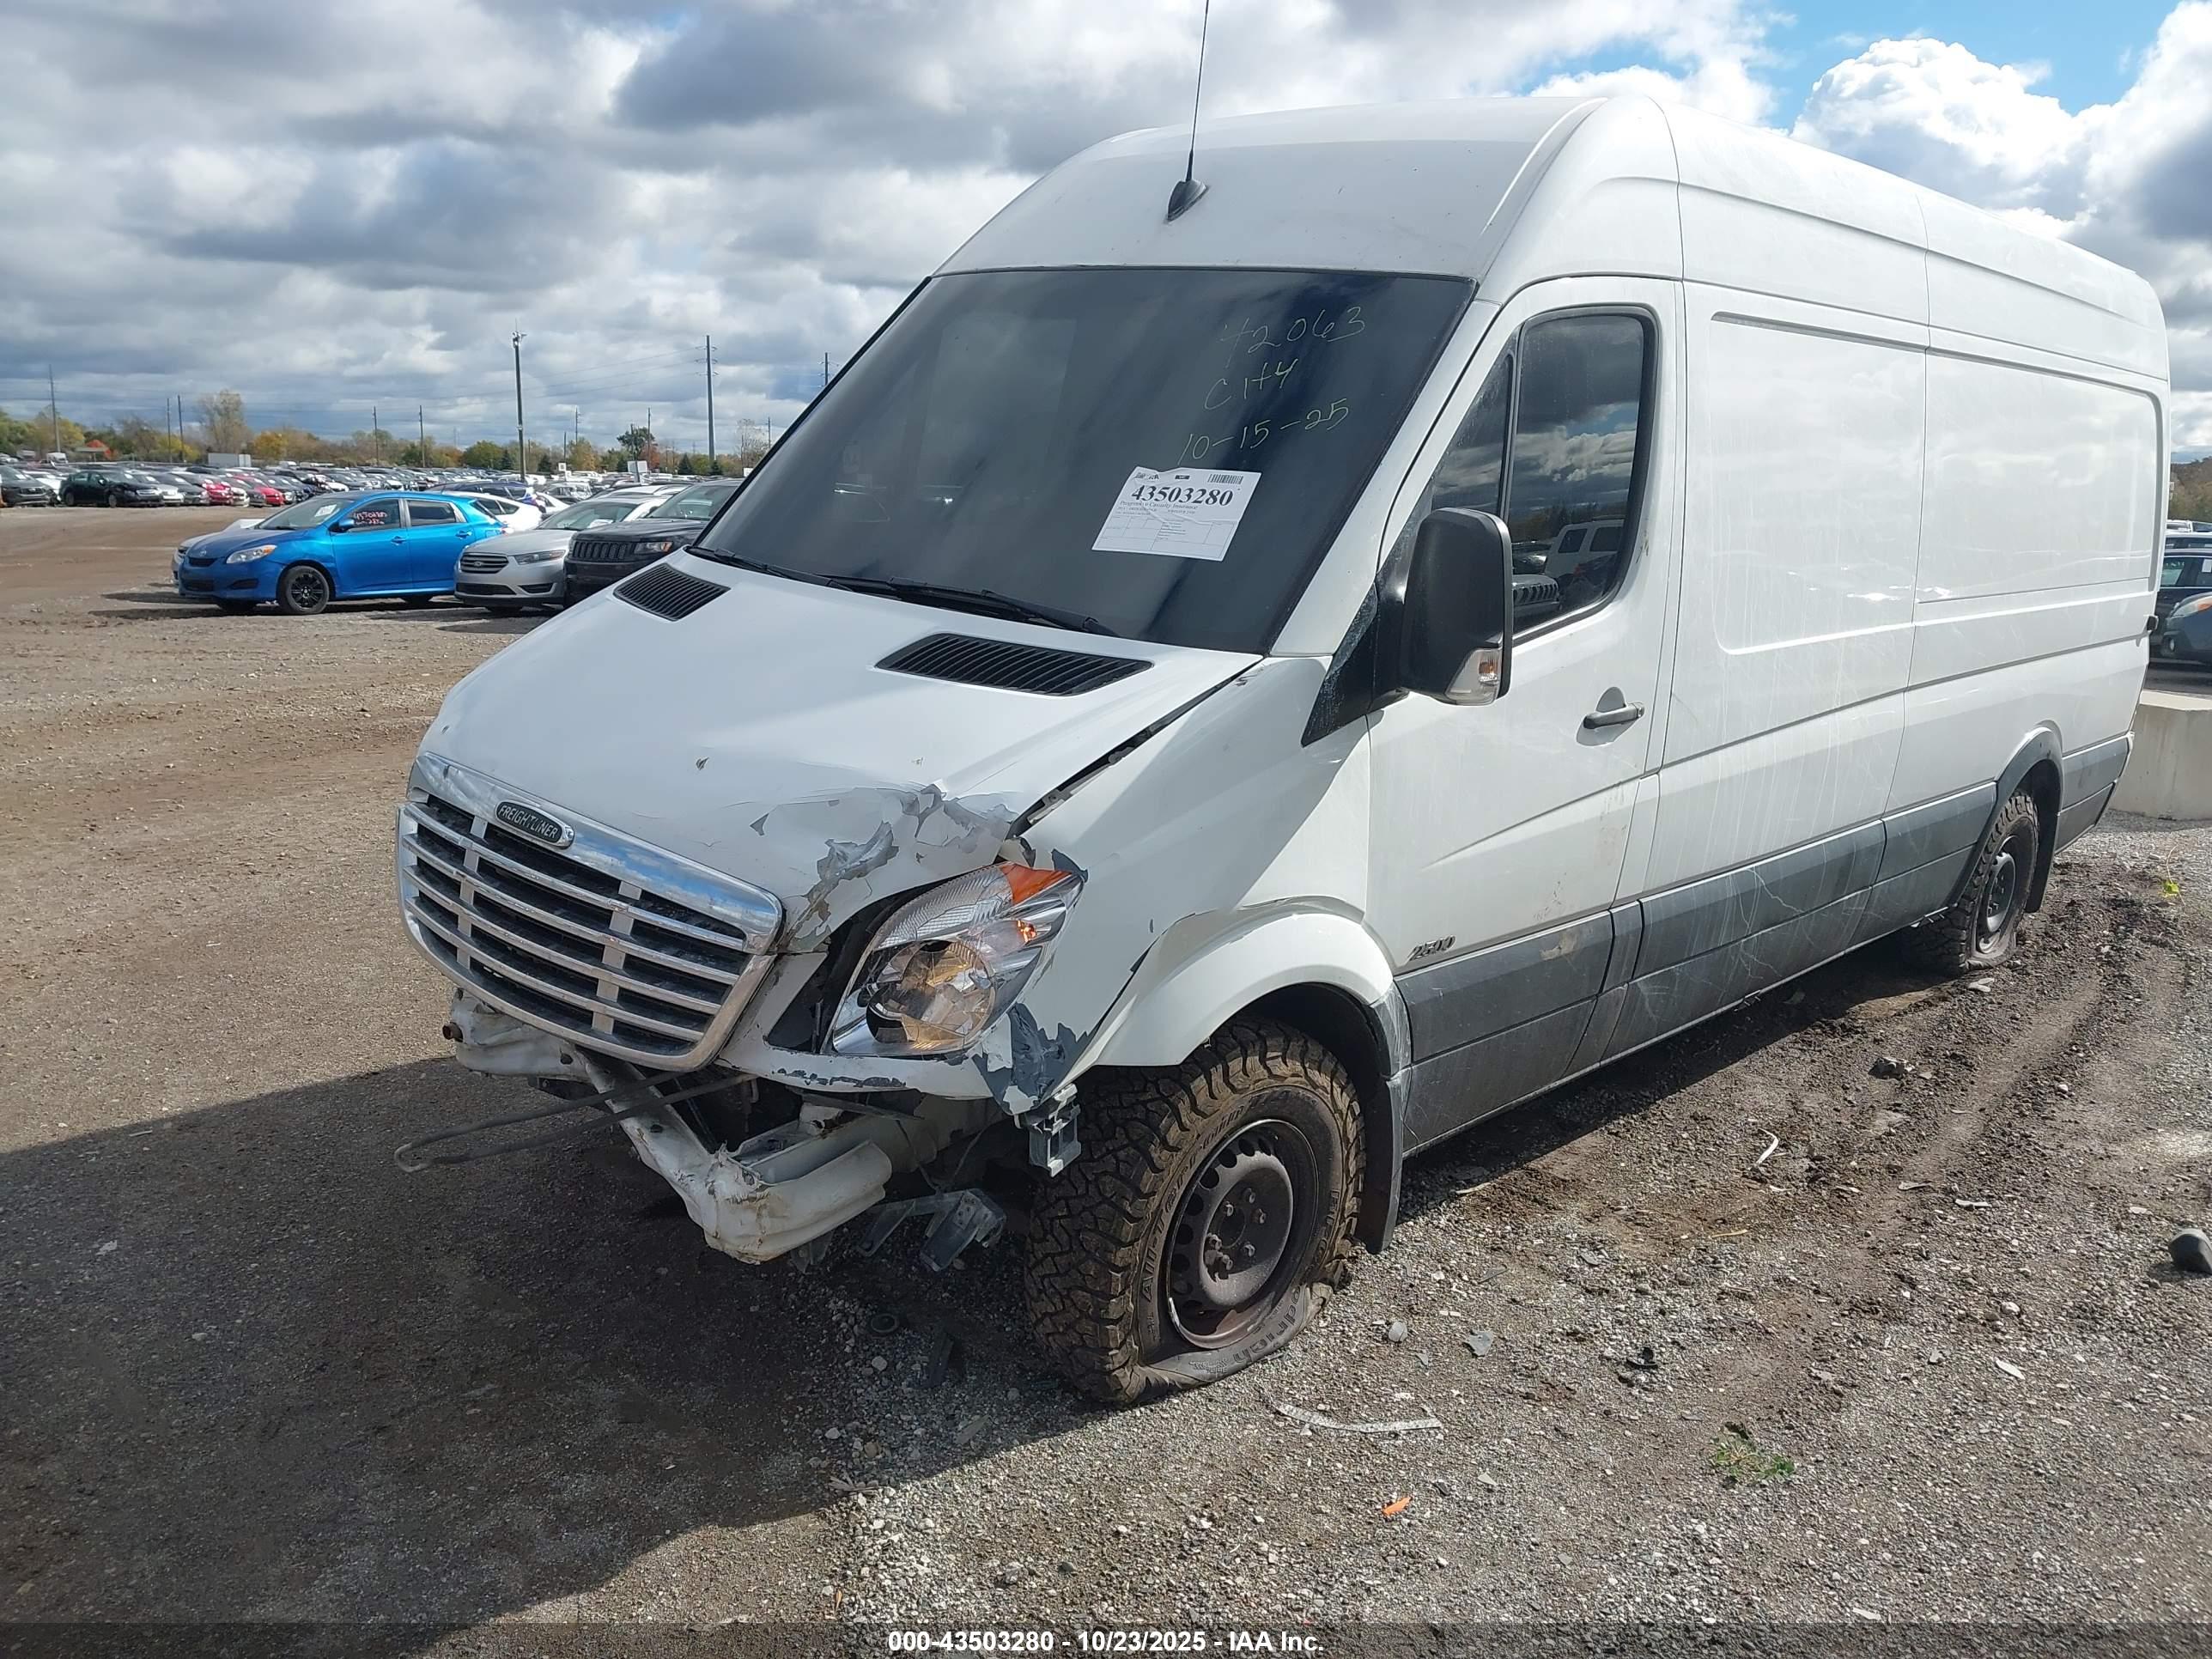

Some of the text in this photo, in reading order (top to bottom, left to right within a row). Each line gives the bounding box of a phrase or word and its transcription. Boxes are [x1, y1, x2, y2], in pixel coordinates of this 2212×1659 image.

[1177, 398, 1349, 465] 10-15-25
[1132, 484, 1234, 507] 43503280
[497, 805, 558, 839] FREIGHTLINER
